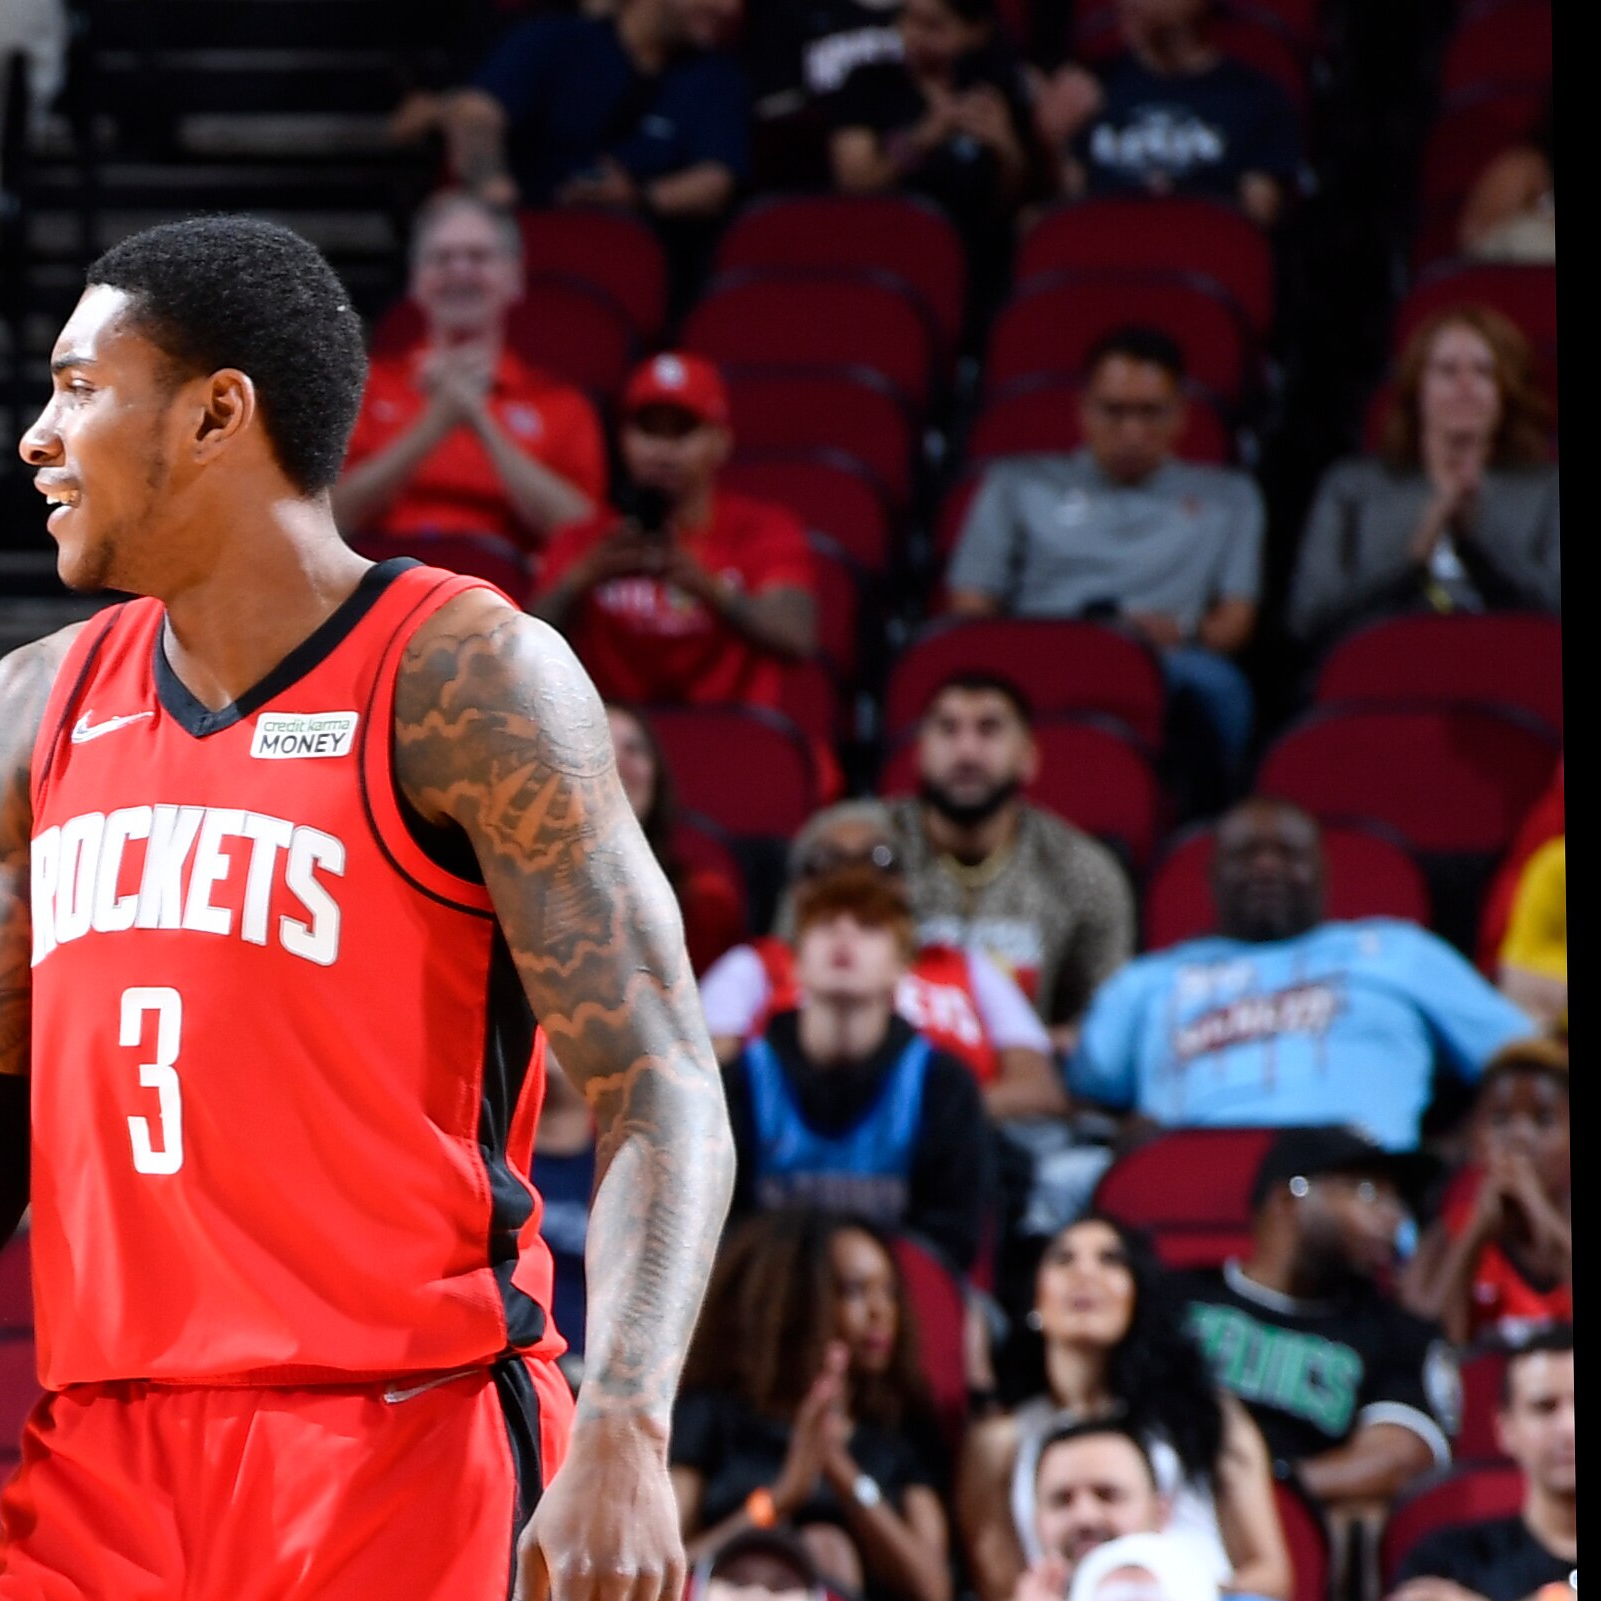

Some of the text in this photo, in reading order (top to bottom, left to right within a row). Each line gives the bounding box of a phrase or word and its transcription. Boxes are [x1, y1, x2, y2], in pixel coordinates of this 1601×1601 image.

[259, 732, 346, 754] MONEY
[264, 718, 350, 732] credit karma
[30, 803, 346, 967] ROCKETS
[118, 986, 184, 1175] 3
